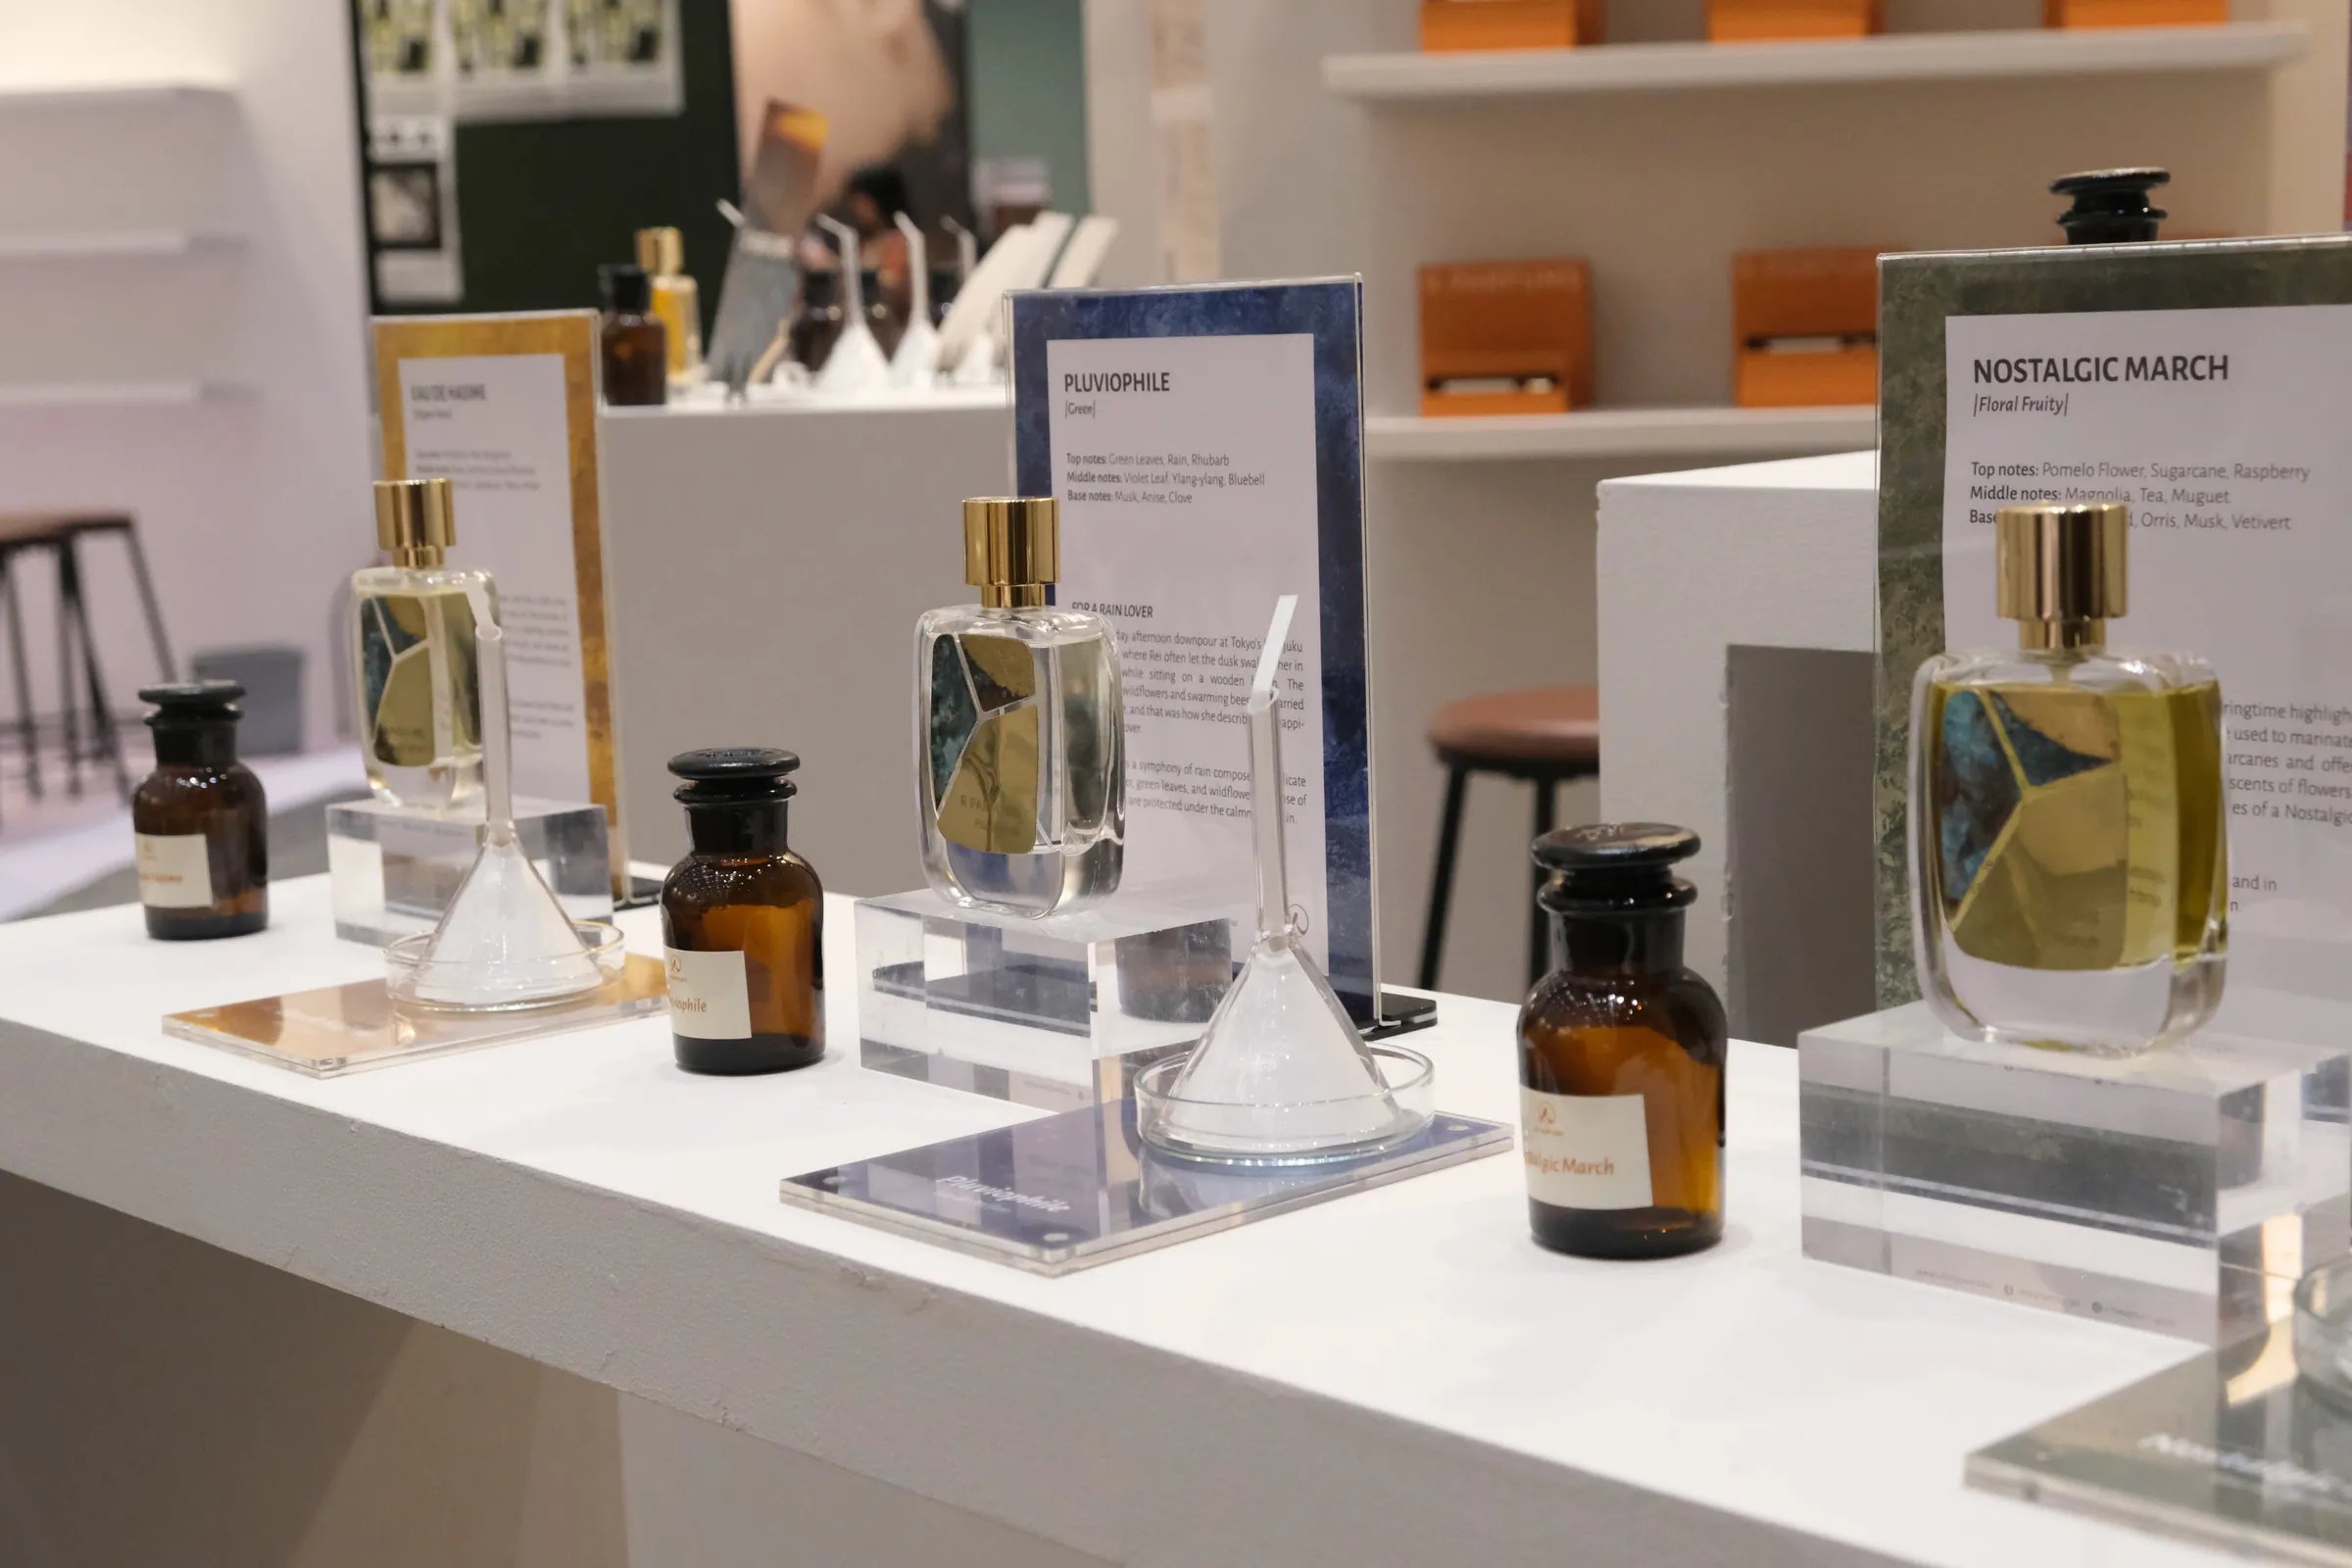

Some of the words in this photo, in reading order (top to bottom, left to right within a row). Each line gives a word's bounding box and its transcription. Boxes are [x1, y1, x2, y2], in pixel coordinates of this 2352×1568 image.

[1974, 358, 2119, 383] NOSTALGIC
[2125, 355, 2229, 381] MARCH
[1064, 372, 1170, 392] PLUVIOPHILE
[1066, 453, 1081, 466] Top
[1083, 454, 1106, 465] notes:
[1108, 453, 1134, 466] Green
[1136, 454, 1166, 466] Leaves,
[1168, 454, 1190, 466] Rain,
[1192, 454, 1230, 466] Rhubarb
[1067, 471, 1096, 483] Middle
[1098, 472, 1122, 484] notes:
[1124, 472, 1149, 484] Violet
[1172, 472, 1226, 488] Ylang-ylang,
[1228, 473, 1265, 486] Bluebell
[1972, 462, 1995, 478] Top
[1998, 465, 2038, 476] notes:
[2042, 462, 2095, 477] Pomelo
[2098, 462, 2147, 478] Flower,
[2150, 463, 2230, 481] Sugarcane,
[2234, 463, 2311, 483] Raspberry
[1067, 490, 1087, 501] Base
[1089, 491, 1112, 503] notes:
[1115, 491, 1140, 504] Musk,
[1142, 492, 1167, 504] Anise,
[1169, 492, 1193, 504] Clove
[1971, 485, 2018, 501] Middle
[2021, 488, 2062, 501] notes:
[2139, 487, 2168, 504] Tea,
[2171, 488, 2230, 507] Muguet
[2141, 512, 2180, 529] Orris,
[2183, 514, 2228, 530] Musk,
[2231, 513, 2291, 530] Vetivert
[1092, 604, 1098, 612] A
[1100, 604, 1122, 616] RAIN
[1124, 605, 1153, 618] LOVER
[1132, 630, 1172, 644] afternoon
[1173, 632, 1217, 648] downpour
[1219, 637, 1228, 648] at
[1231, 636, 1262, 651] Tokyo's
[1122, 649, 1148, 661] where
[1164, 651, 1187, 663] often
[1189, 652, 1200, 664] let
[1201, 654, 1216, 665] the
[1218, 655, 1239, 667] dusk
[1295, 660, 1303, 671] in
[1122, 667, 1144, 678] while
[1150, 669, 1176, 684] sitting
[1182, 673, 1194, 683] on
[1200, 674, 1204, 683] a
[1210, 674, 1245, 686] wooden
[1287, 678, 1304, 691] The
[1123, 685, 1168, 700] wildflowers
[1170, 689, 1186, 701] and
[1188, 692, 1229, 707] swarming
[1129, 705, 1146, 715] and
[1147, 705, 1164, 717] that
[1165, 709, 1181, 719] was
[1182, 708, 1200, 720] how
[1200, 710, 1216, 722] she
[2224, 702, 2286, 720] ringtime
[2234, 727, 2268, 742] used
[2272, 729, 2286, 743] to
[1139, 760, 1182, 776] symphony
[1184, 762, 1193, 774] of
[1195, 766, 1211, 777] rain
[2285, 755, 2315, 770] and
[1137, 778, 1160, 791] green
[1161, 780, 1190, 794] leaves,
[1192, 784, 1207, 796] and
[1209, 785, 1250, 800] wildflowe
[1298, 793, 1307, 806] of
[2229, 777, 2275, 793] scents
[2278, 777, 2295, 794] of
[1144, 798, 1182, 811] protected
[1184, 802, 1208, 814] under
[1210, 804, 1224, 815] the
[2252, 801, 2268, 816] of
[2272, 806, 2279, 818] a
[2231, 875, 2260, 890] and
[2263, 876, 2278, 891] in
[1562, 1157, 1614, 1175] March
